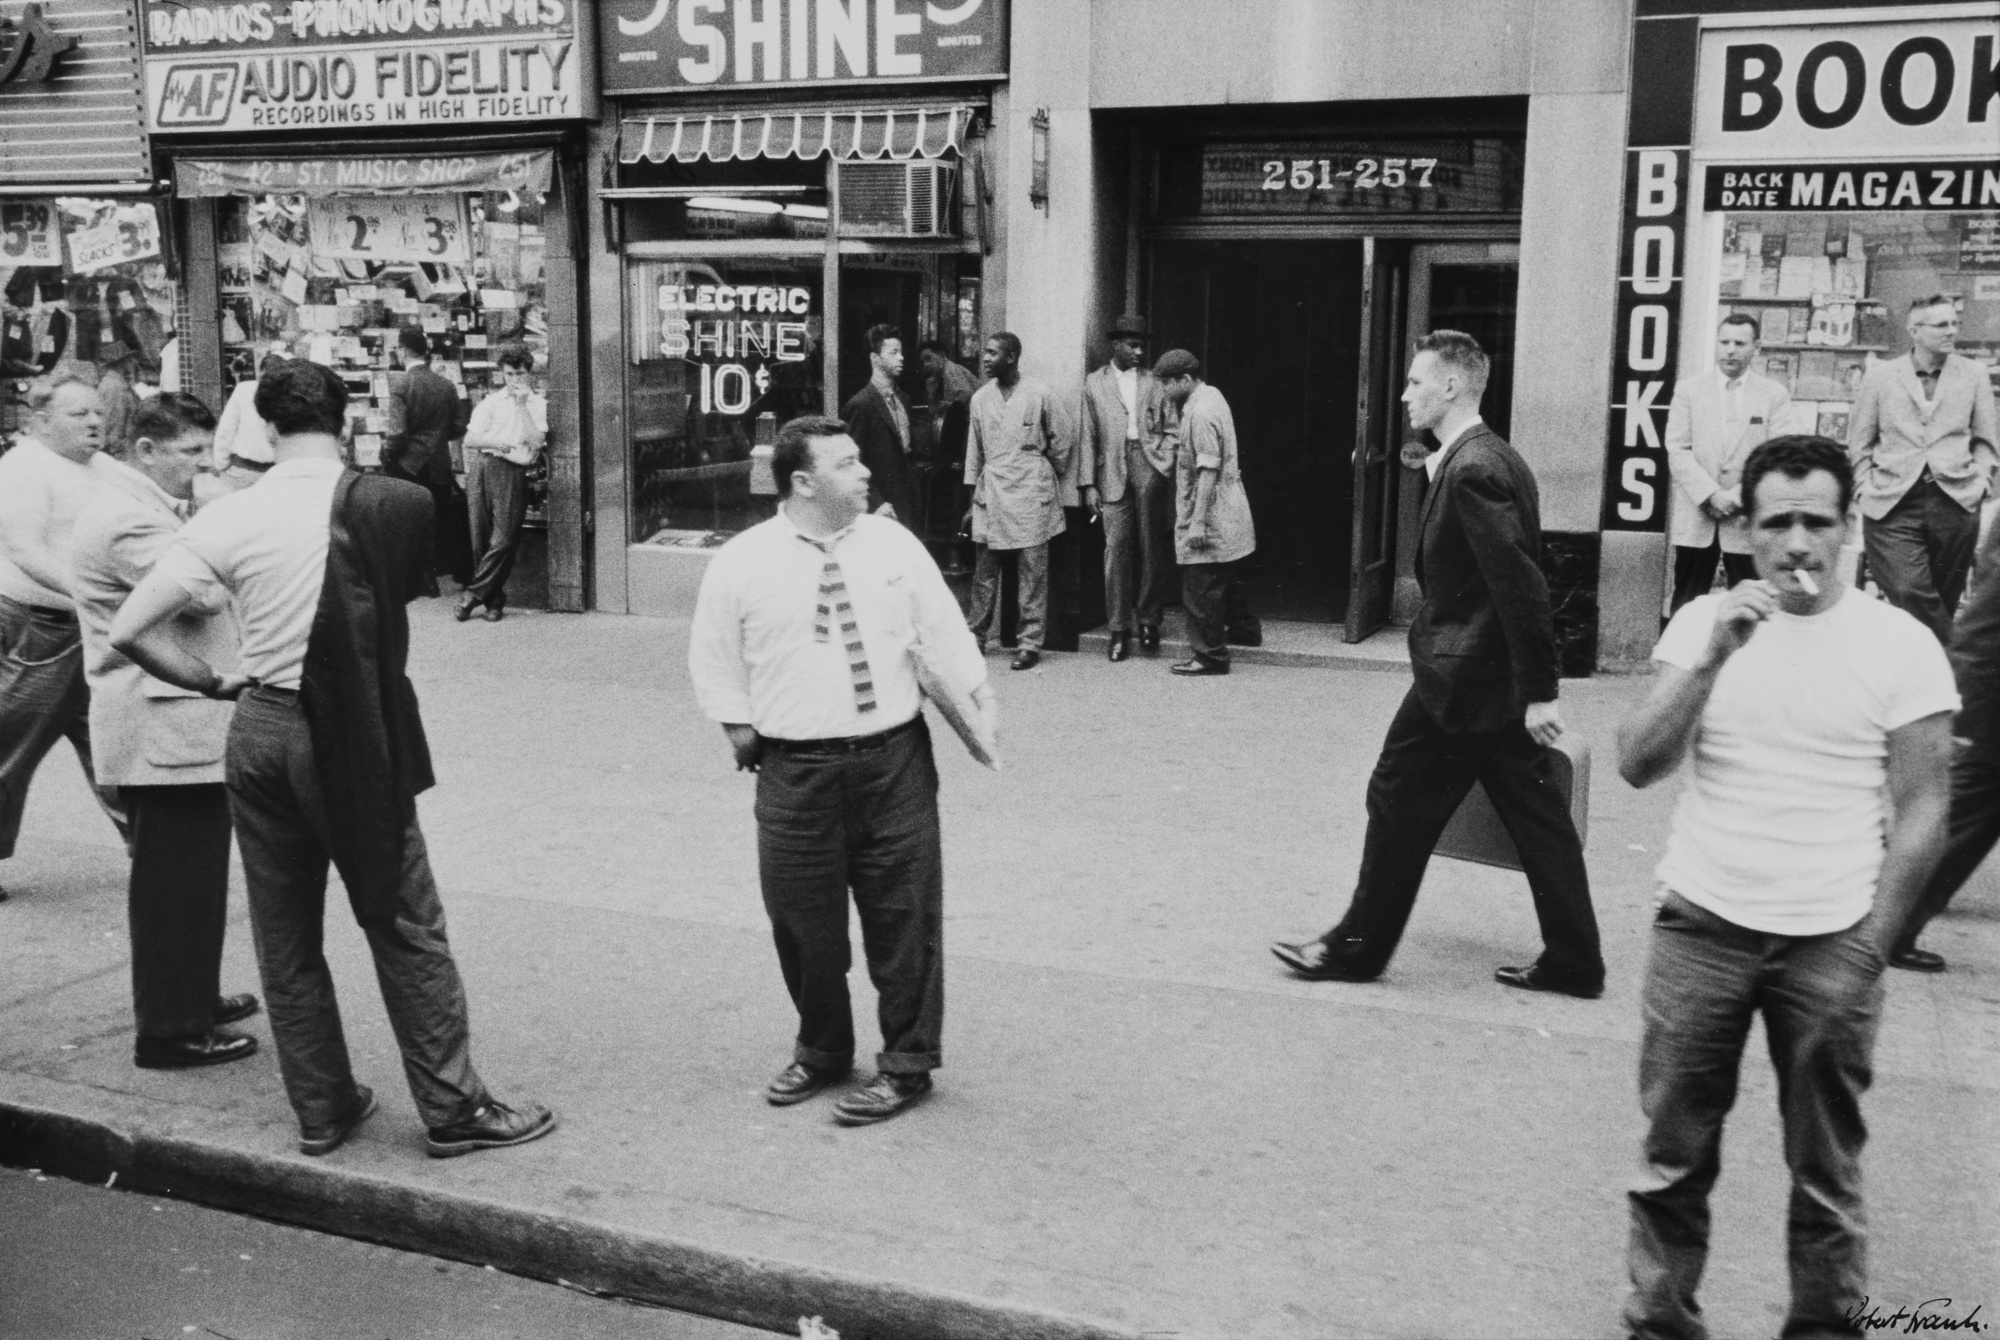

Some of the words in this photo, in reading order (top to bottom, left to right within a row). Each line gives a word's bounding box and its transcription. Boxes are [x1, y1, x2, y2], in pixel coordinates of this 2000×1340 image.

[678, 0, 921, 84] SHINE
[239, 57, 357, 104] AUDIO
[375, 43, 573, 99] FIDELITY
[252, 104, 375, 126] RECORDINGS
[387, 102, 406, 120] IN
[419, 99, 465, 119] HIGH
[478, 95, 568, 117] FIDELITY
[297, 160, 328, 186] ST.
[336, 158, 408, 185] MUSIC
[416, 157, 477, 184] SHOP
[1262, 158, 1438, 190] 251-257
[1722, 173, 1784, 188] BACK
[1721, 190, 1779, 206] DATE
[658, 284, 810, 314] ELECTRIC
[660, 319, 807, 362] SHINE
[1617, 150, 1679, 522] BOOKS
